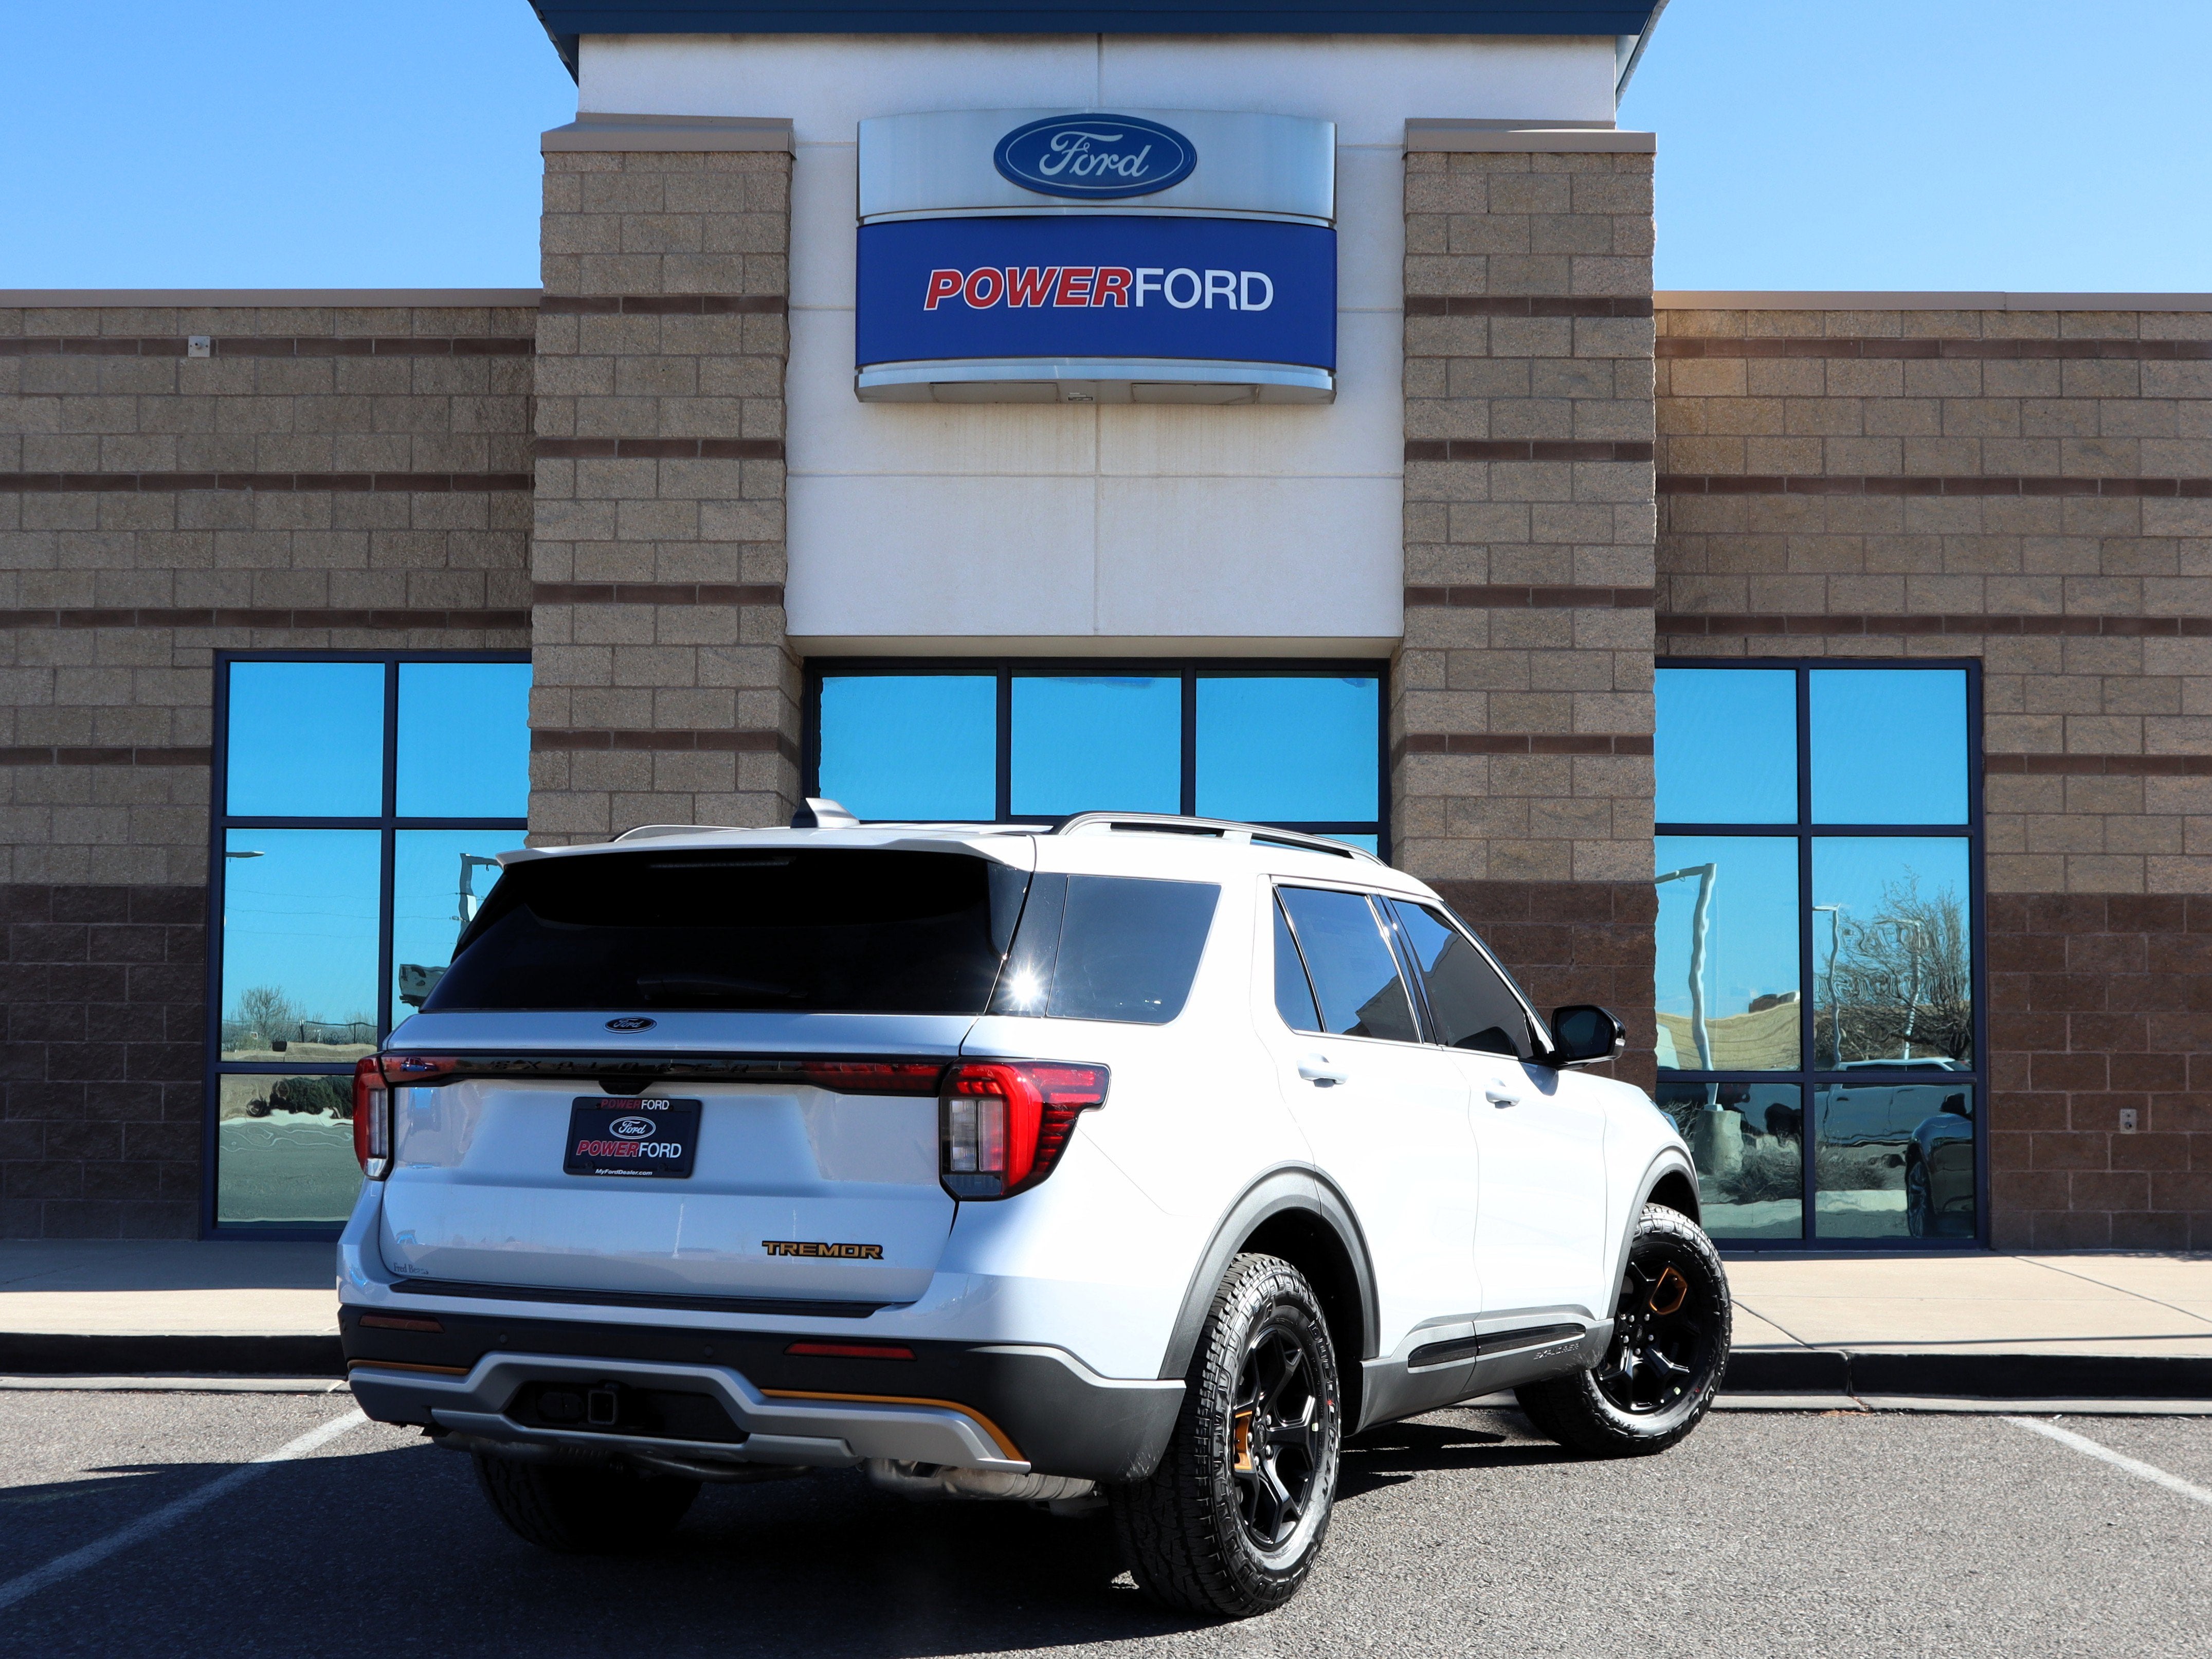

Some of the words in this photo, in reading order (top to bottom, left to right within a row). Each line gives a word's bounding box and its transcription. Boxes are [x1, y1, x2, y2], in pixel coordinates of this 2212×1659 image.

[1039, 131, 1152, 177] Ford
[923, 266, 1274, 312] POWERFORD
[613, 1018, 644, 1028] Ford
[600, 1099, 670, 1110] POWERFORD
[618, 1120, 647, 1134] Ford
[576, 1140, 682, 1158] POWERFORD
[762, 1240, 884, 1259] TREMOR
[1533, 1341, 1581, 1360] EXPLORER
